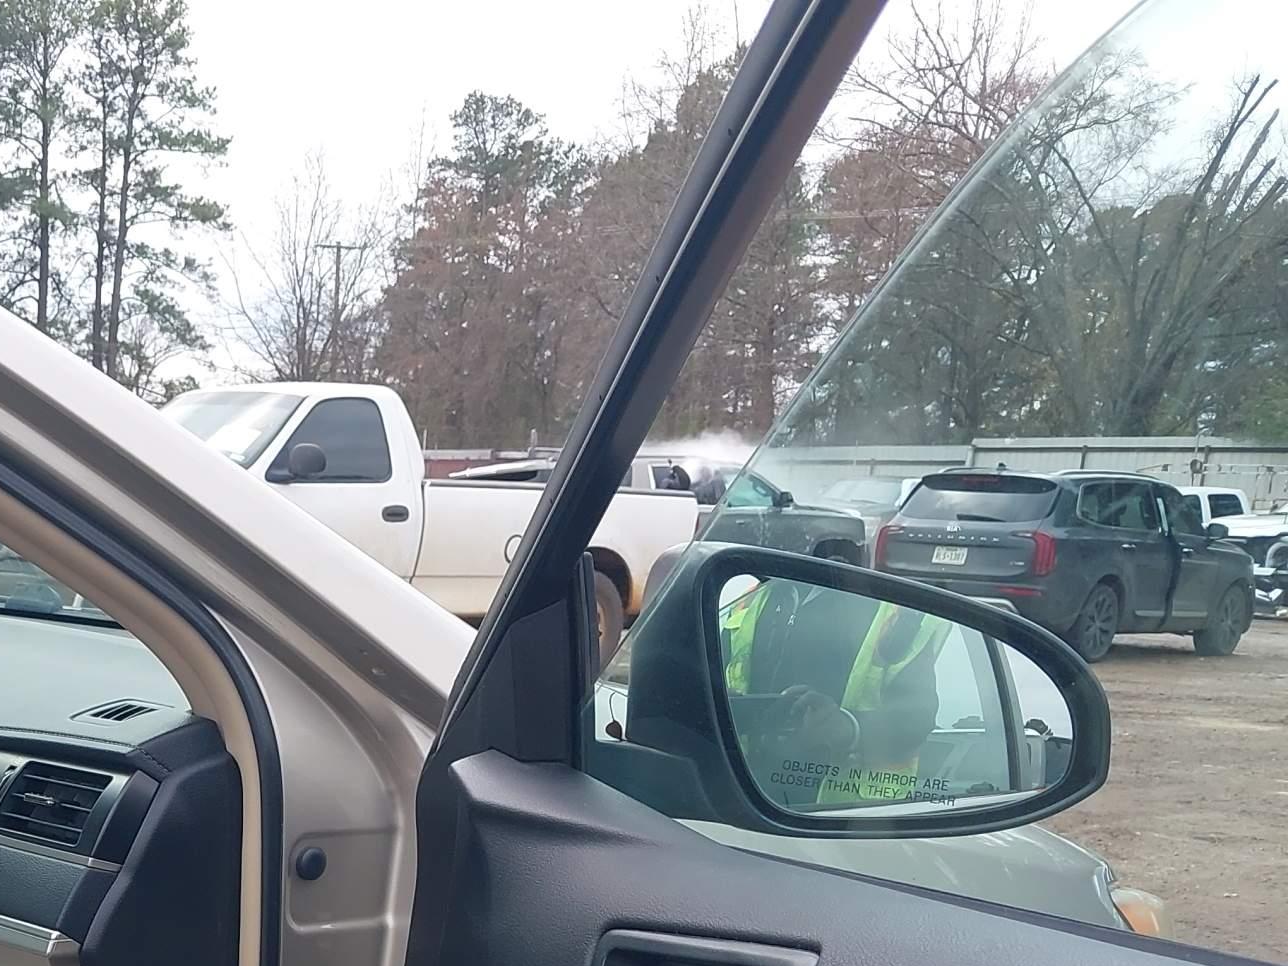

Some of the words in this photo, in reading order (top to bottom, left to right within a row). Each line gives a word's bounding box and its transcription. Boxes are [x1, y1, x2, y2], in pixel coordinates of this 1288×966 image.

[770, 772, 822, 789] CLOSER
[827, 779, 861, 794] THAN
[868, 785, 901, 799] THEY
[905, 791, 956, 807] APPEAR
[782, 759, 839, 777] OBJECTS
[849, 768, 862, 780] IN
[868, 770, 918, 787] MIRROR
[923, 778, 950, 791] ARE
